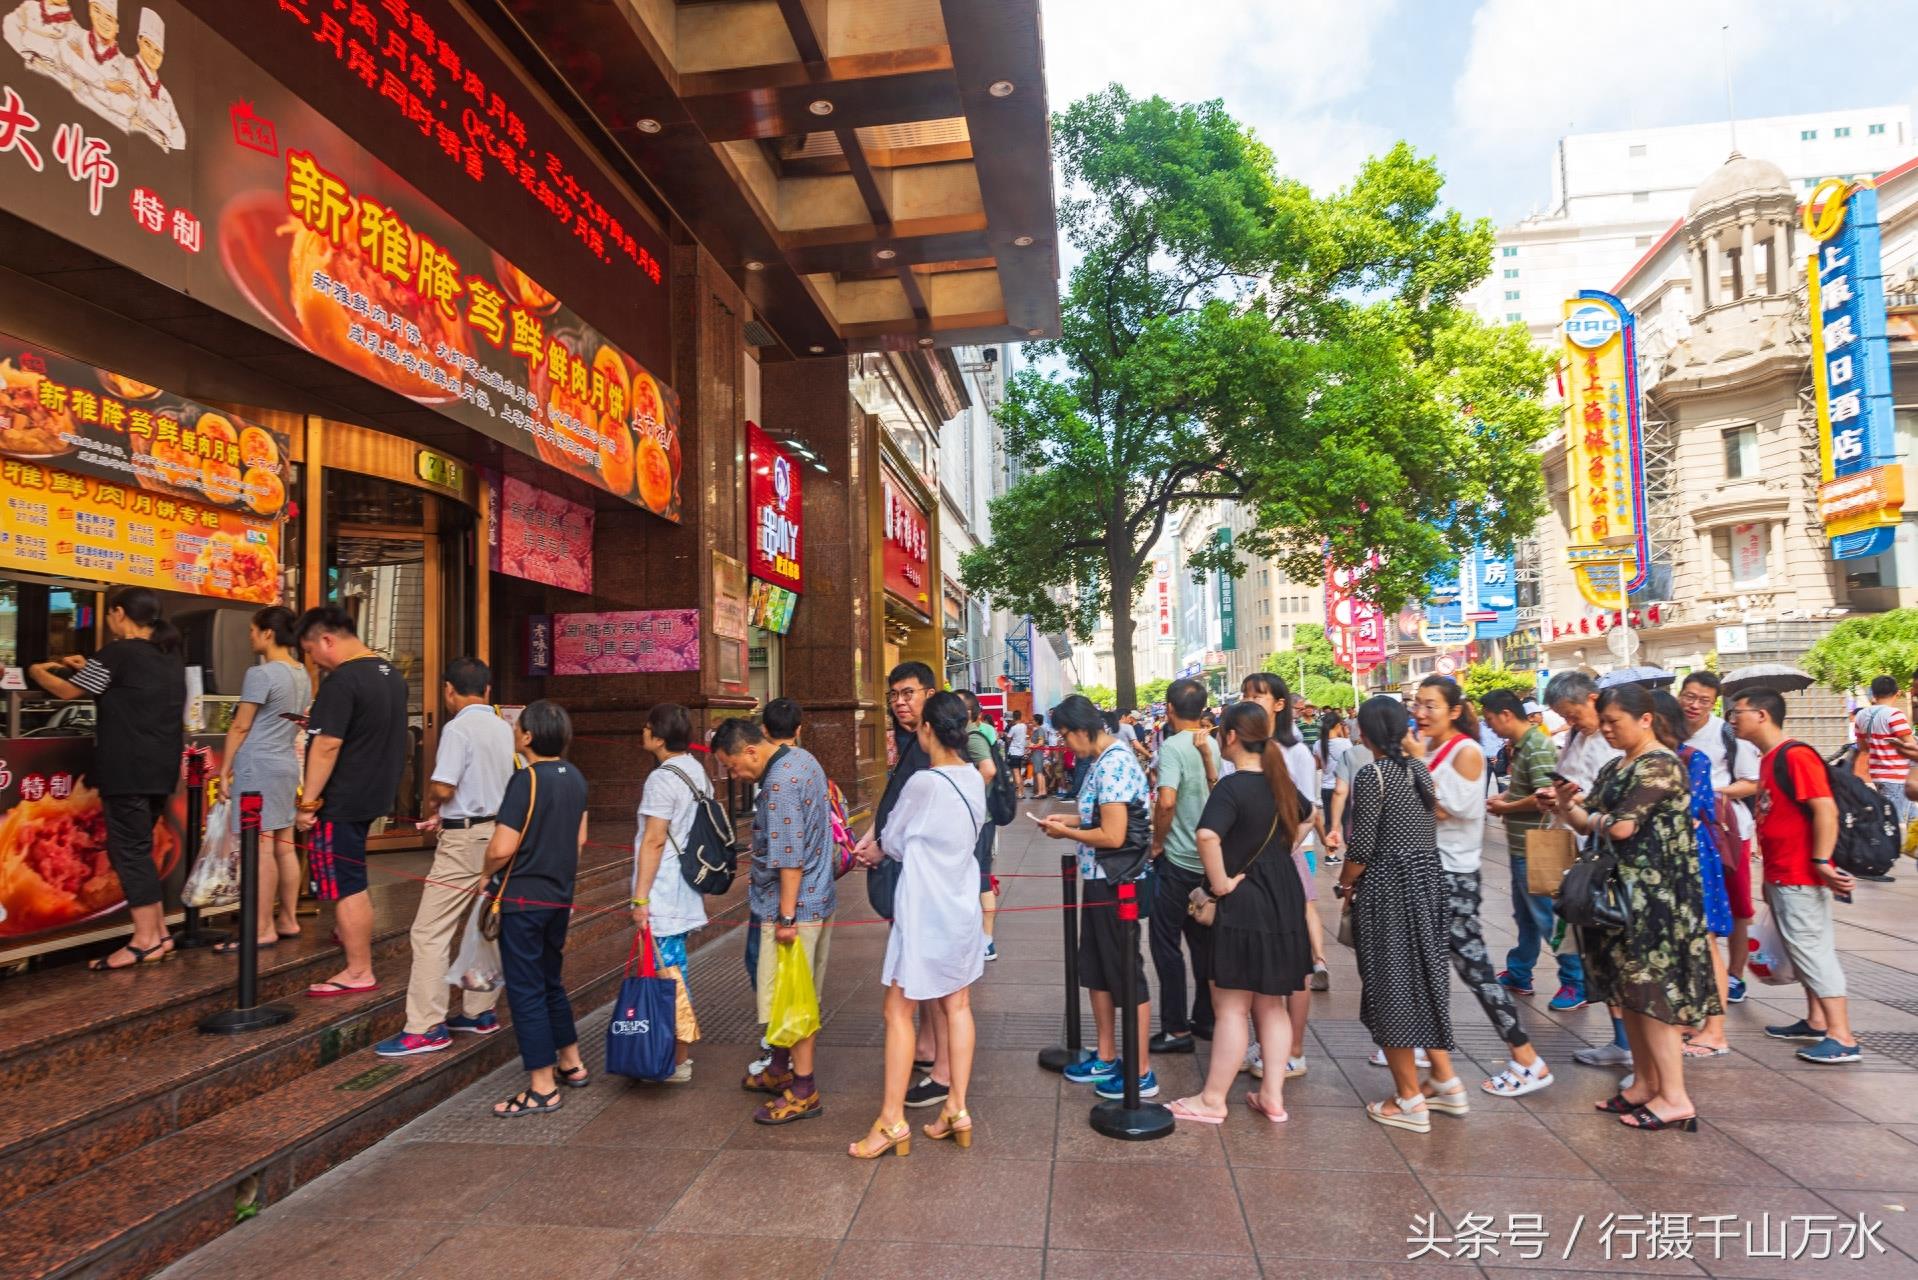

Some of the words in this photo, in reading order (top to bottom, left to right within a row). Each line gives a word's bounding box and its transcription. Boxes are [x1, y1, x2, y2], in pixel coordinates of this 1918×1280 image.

[131, 186, 201, 252] 特制
[20, 774, 72, 801] 特制
[612, 1019, 650, 1035] CHAPS
